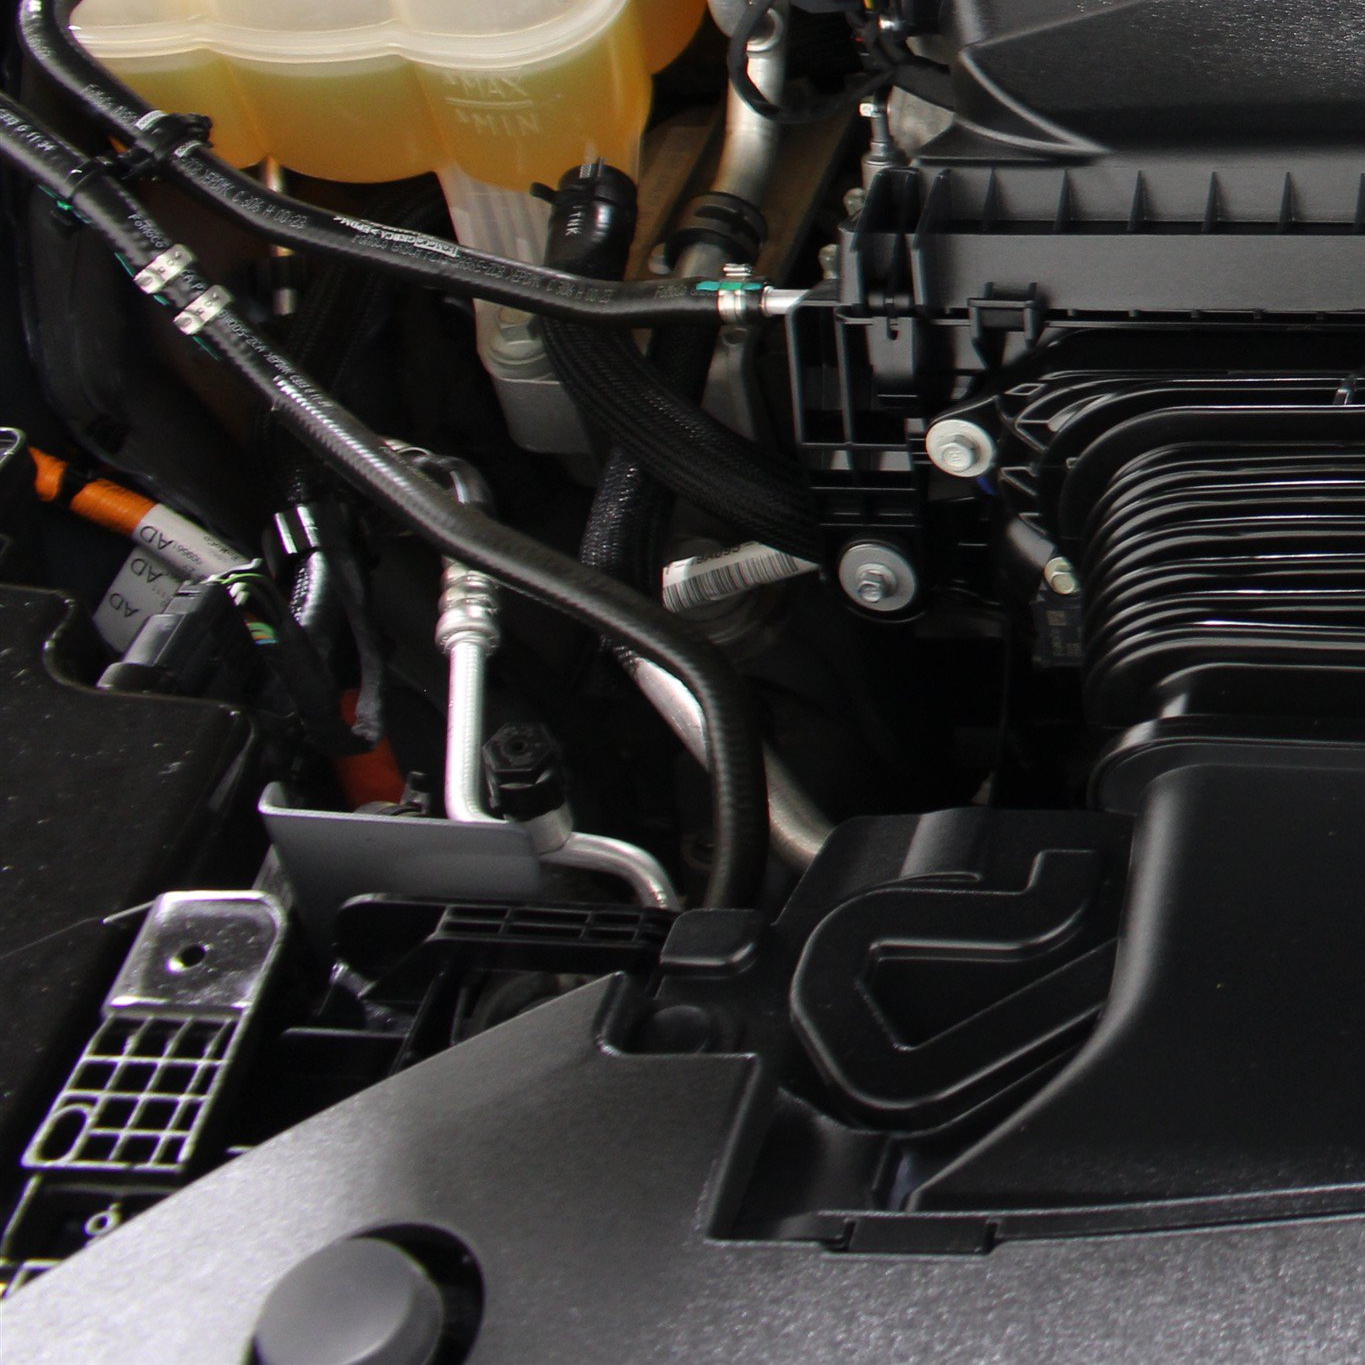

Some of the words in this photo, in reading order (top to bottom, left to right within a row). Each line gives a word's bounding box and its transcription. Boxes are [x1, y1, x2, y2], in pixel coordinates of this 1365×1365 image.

[140, 525, 174, 551] AD
[131, 558, 164, 584] AD
[109, 592, 139, 618] AD
